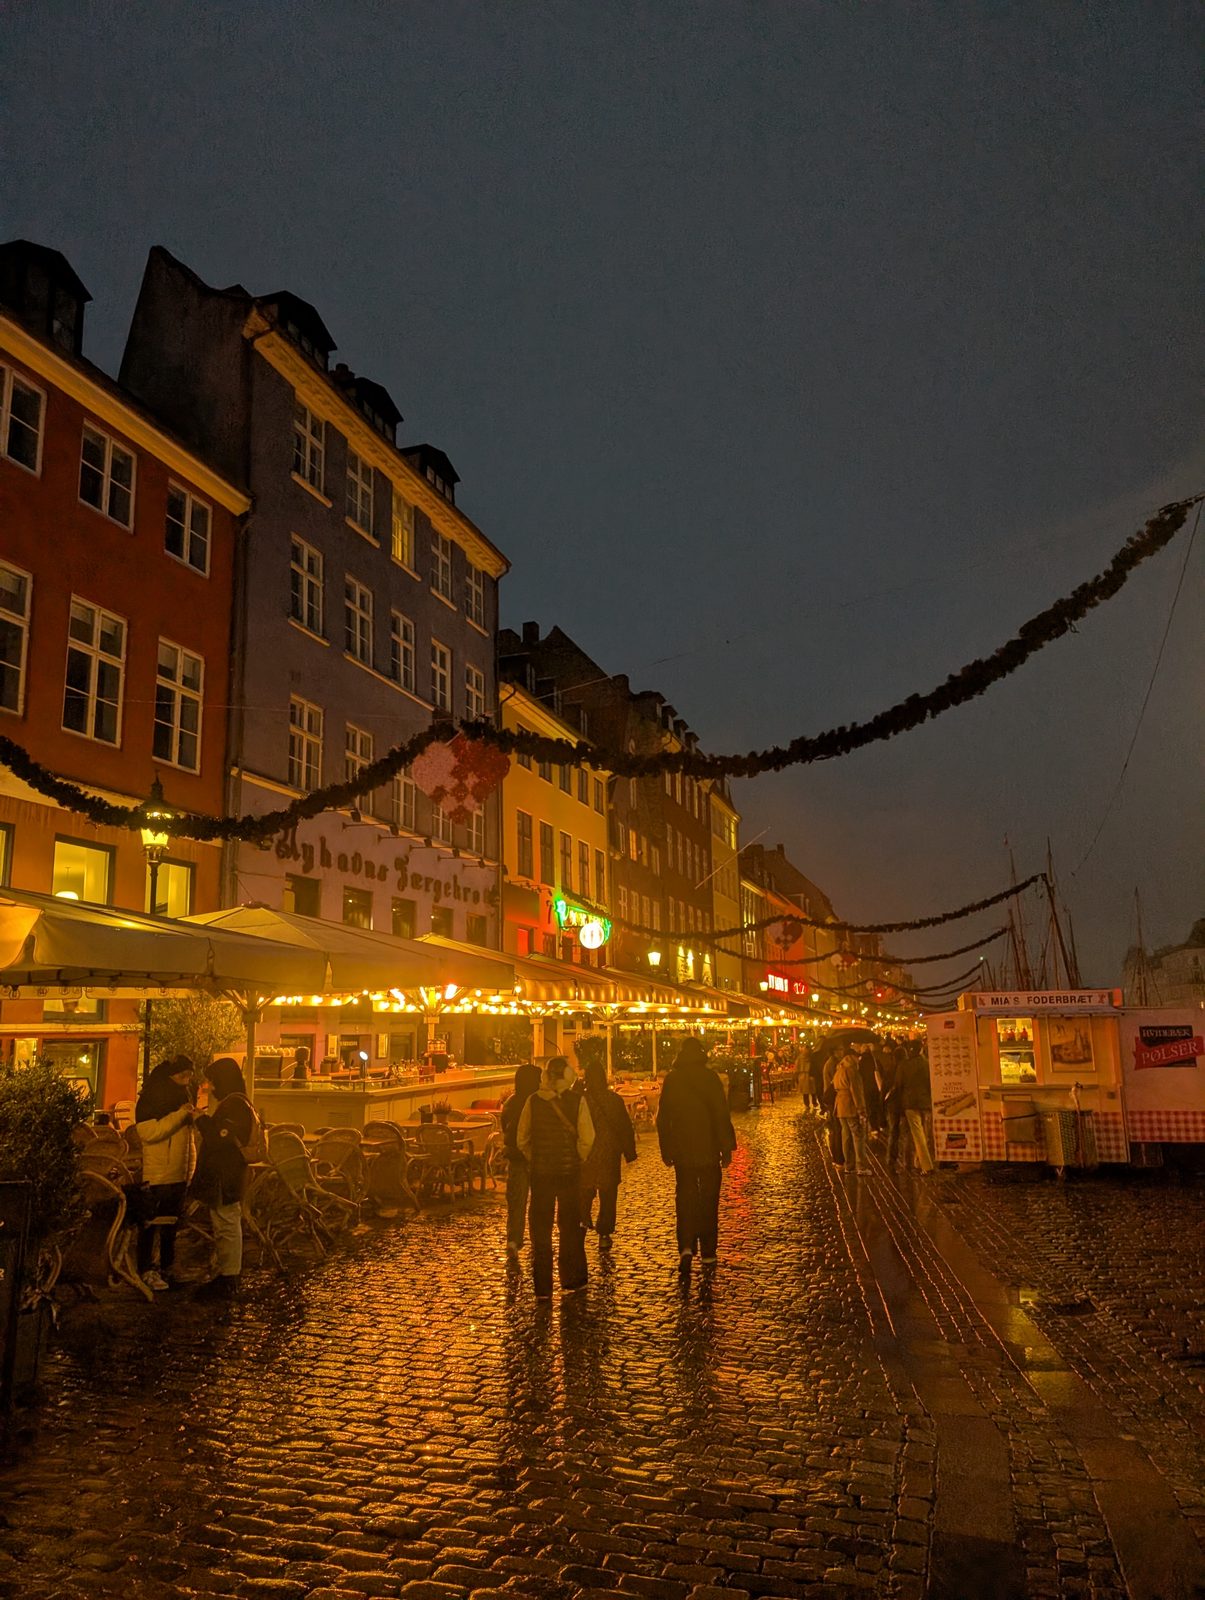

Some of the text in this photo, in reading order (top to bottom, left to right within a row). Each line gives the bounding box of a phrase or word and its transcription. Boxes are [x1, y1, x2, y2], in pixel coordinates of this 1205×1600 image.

[991, 994, 1094, 1006] MIA'S FODERBRÆT
[1141, 1042, 1199, 1065] PØLSER
